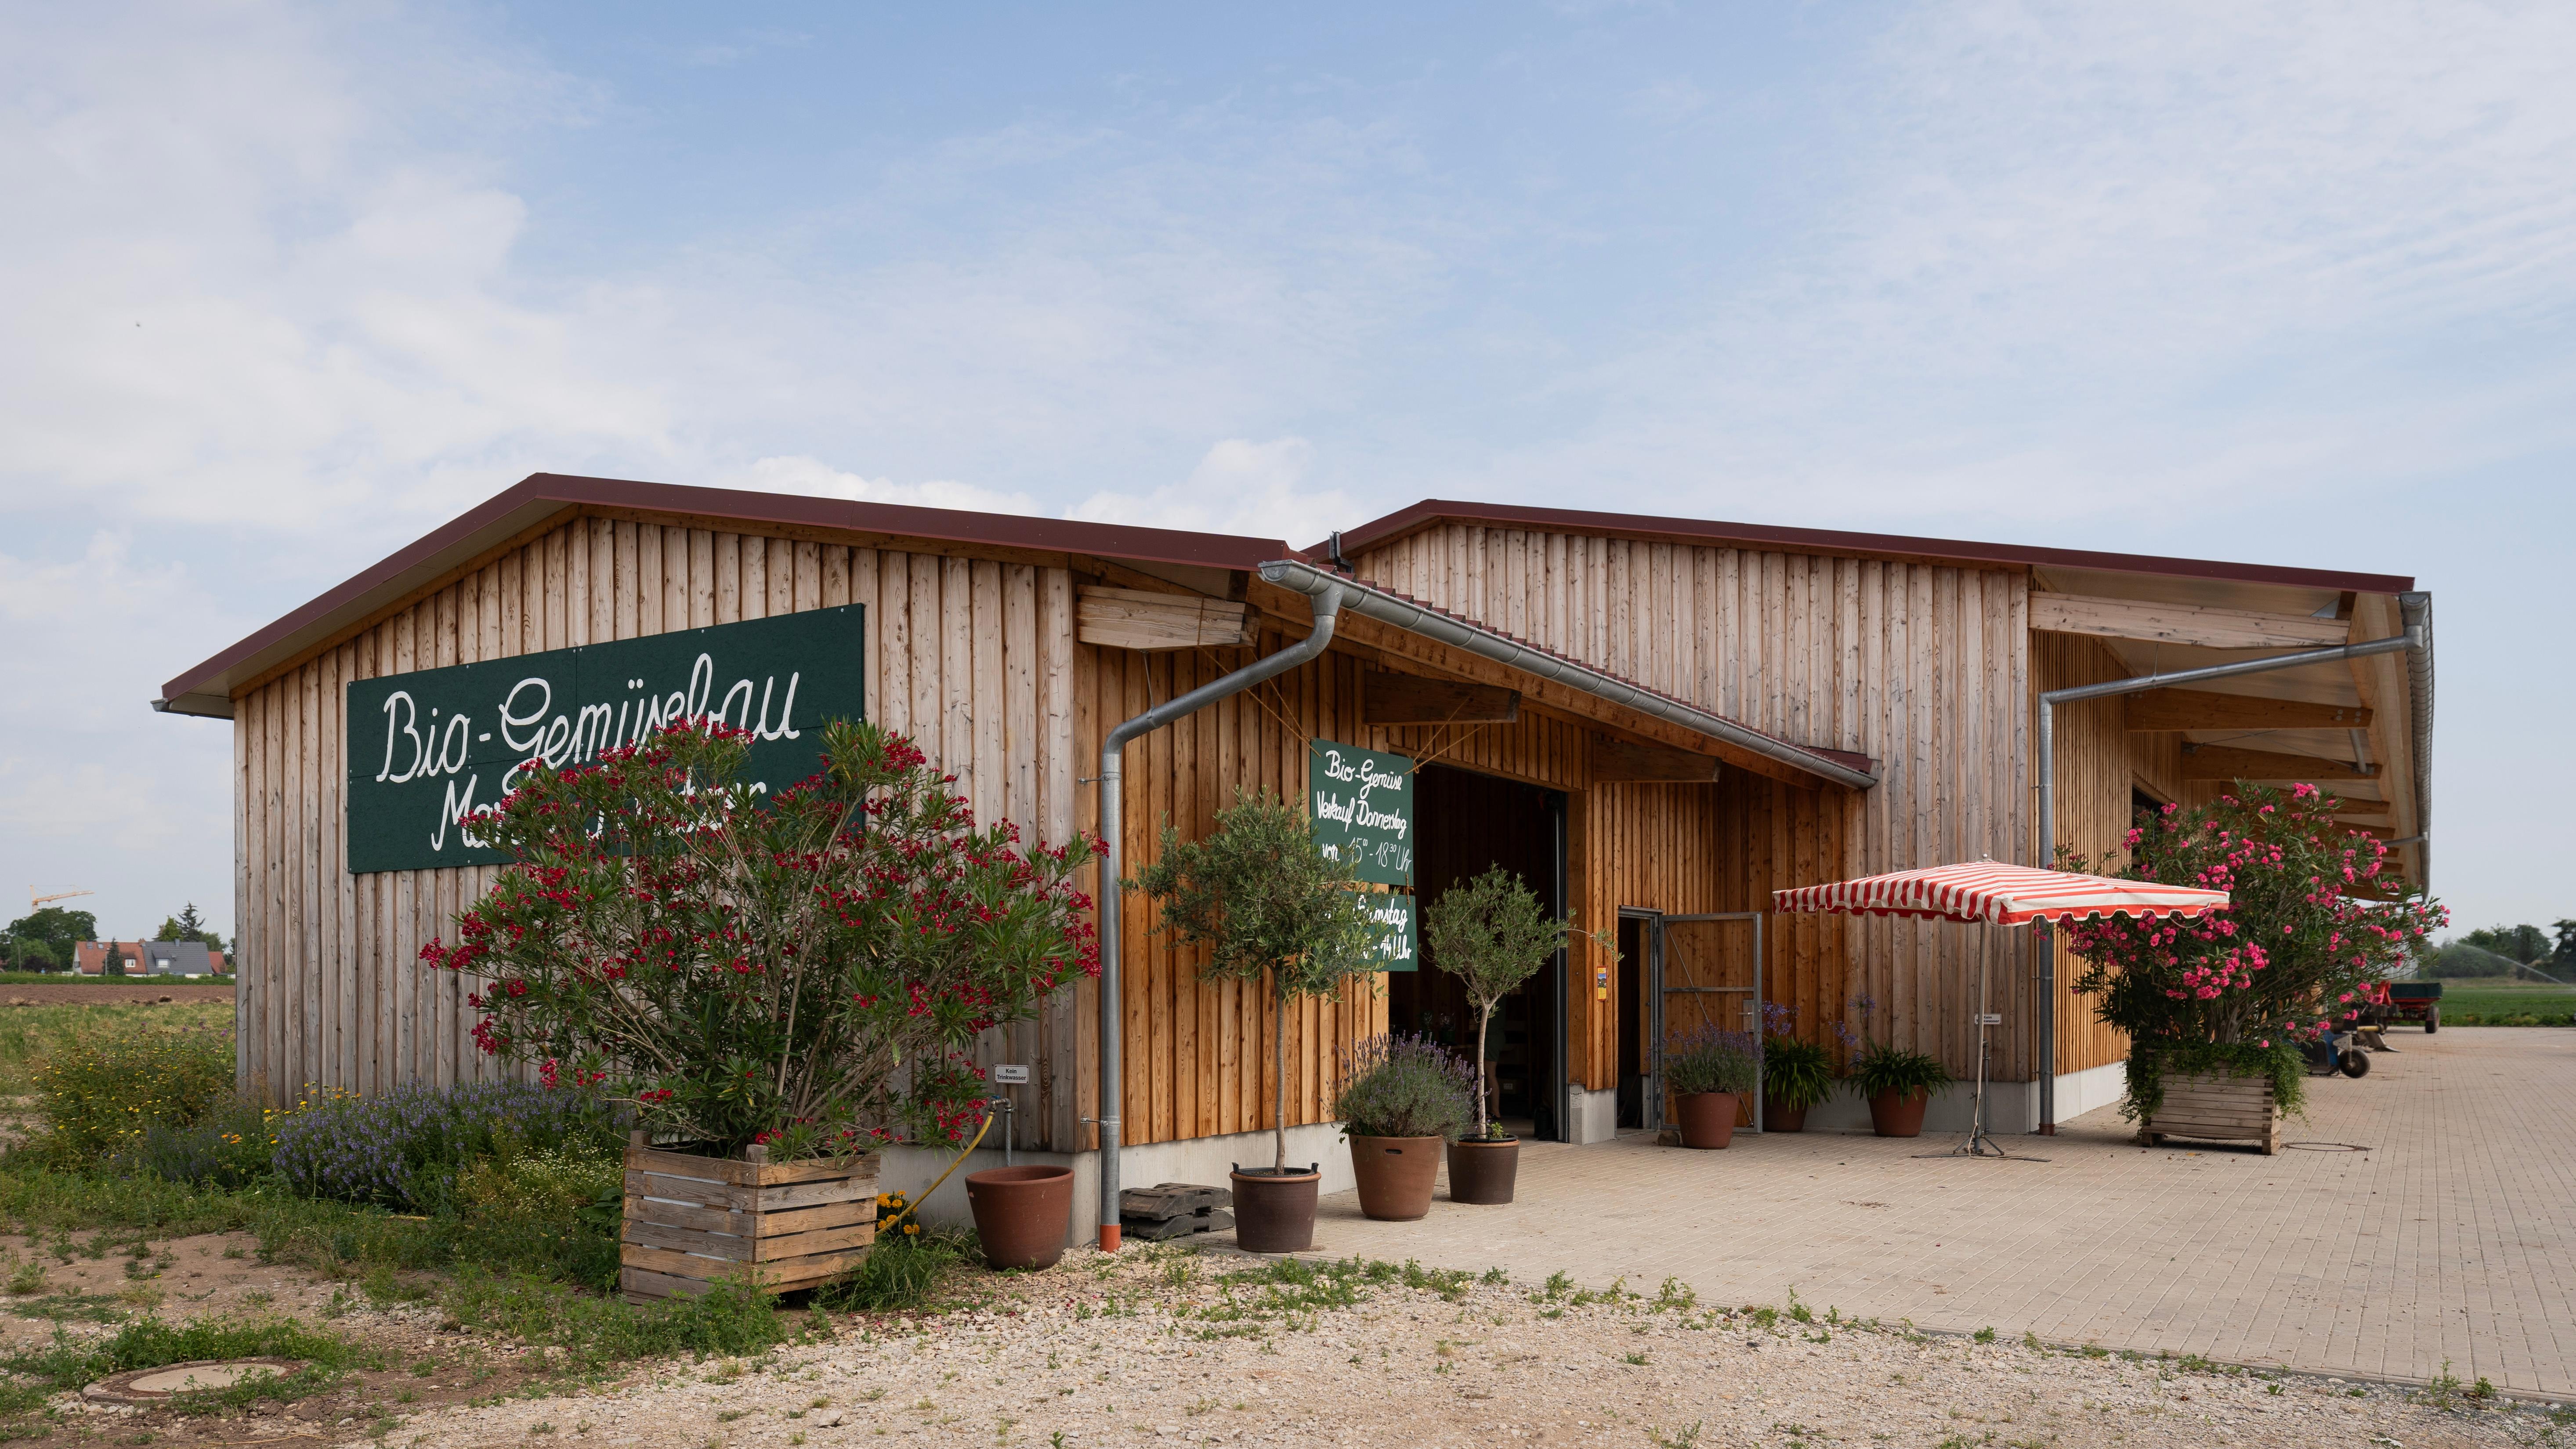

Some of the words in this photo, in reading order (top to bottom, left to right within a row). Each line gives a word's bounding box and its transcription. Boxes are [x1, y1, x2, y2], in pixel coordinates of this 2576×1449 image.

[376, 653, 800, 796] Bio-Gemüsebau
[1325, 750, 1403, 800] Bio-Gemüse
[1317, 790, 1355, 833] Verkauf
[1356, 800, 1407, 840] Donnerstag
[1322, 843, 1340, 862] von
[1395, 845, 1412, 872] Uhr
[1393, 935, 1411, 960] Uhr
